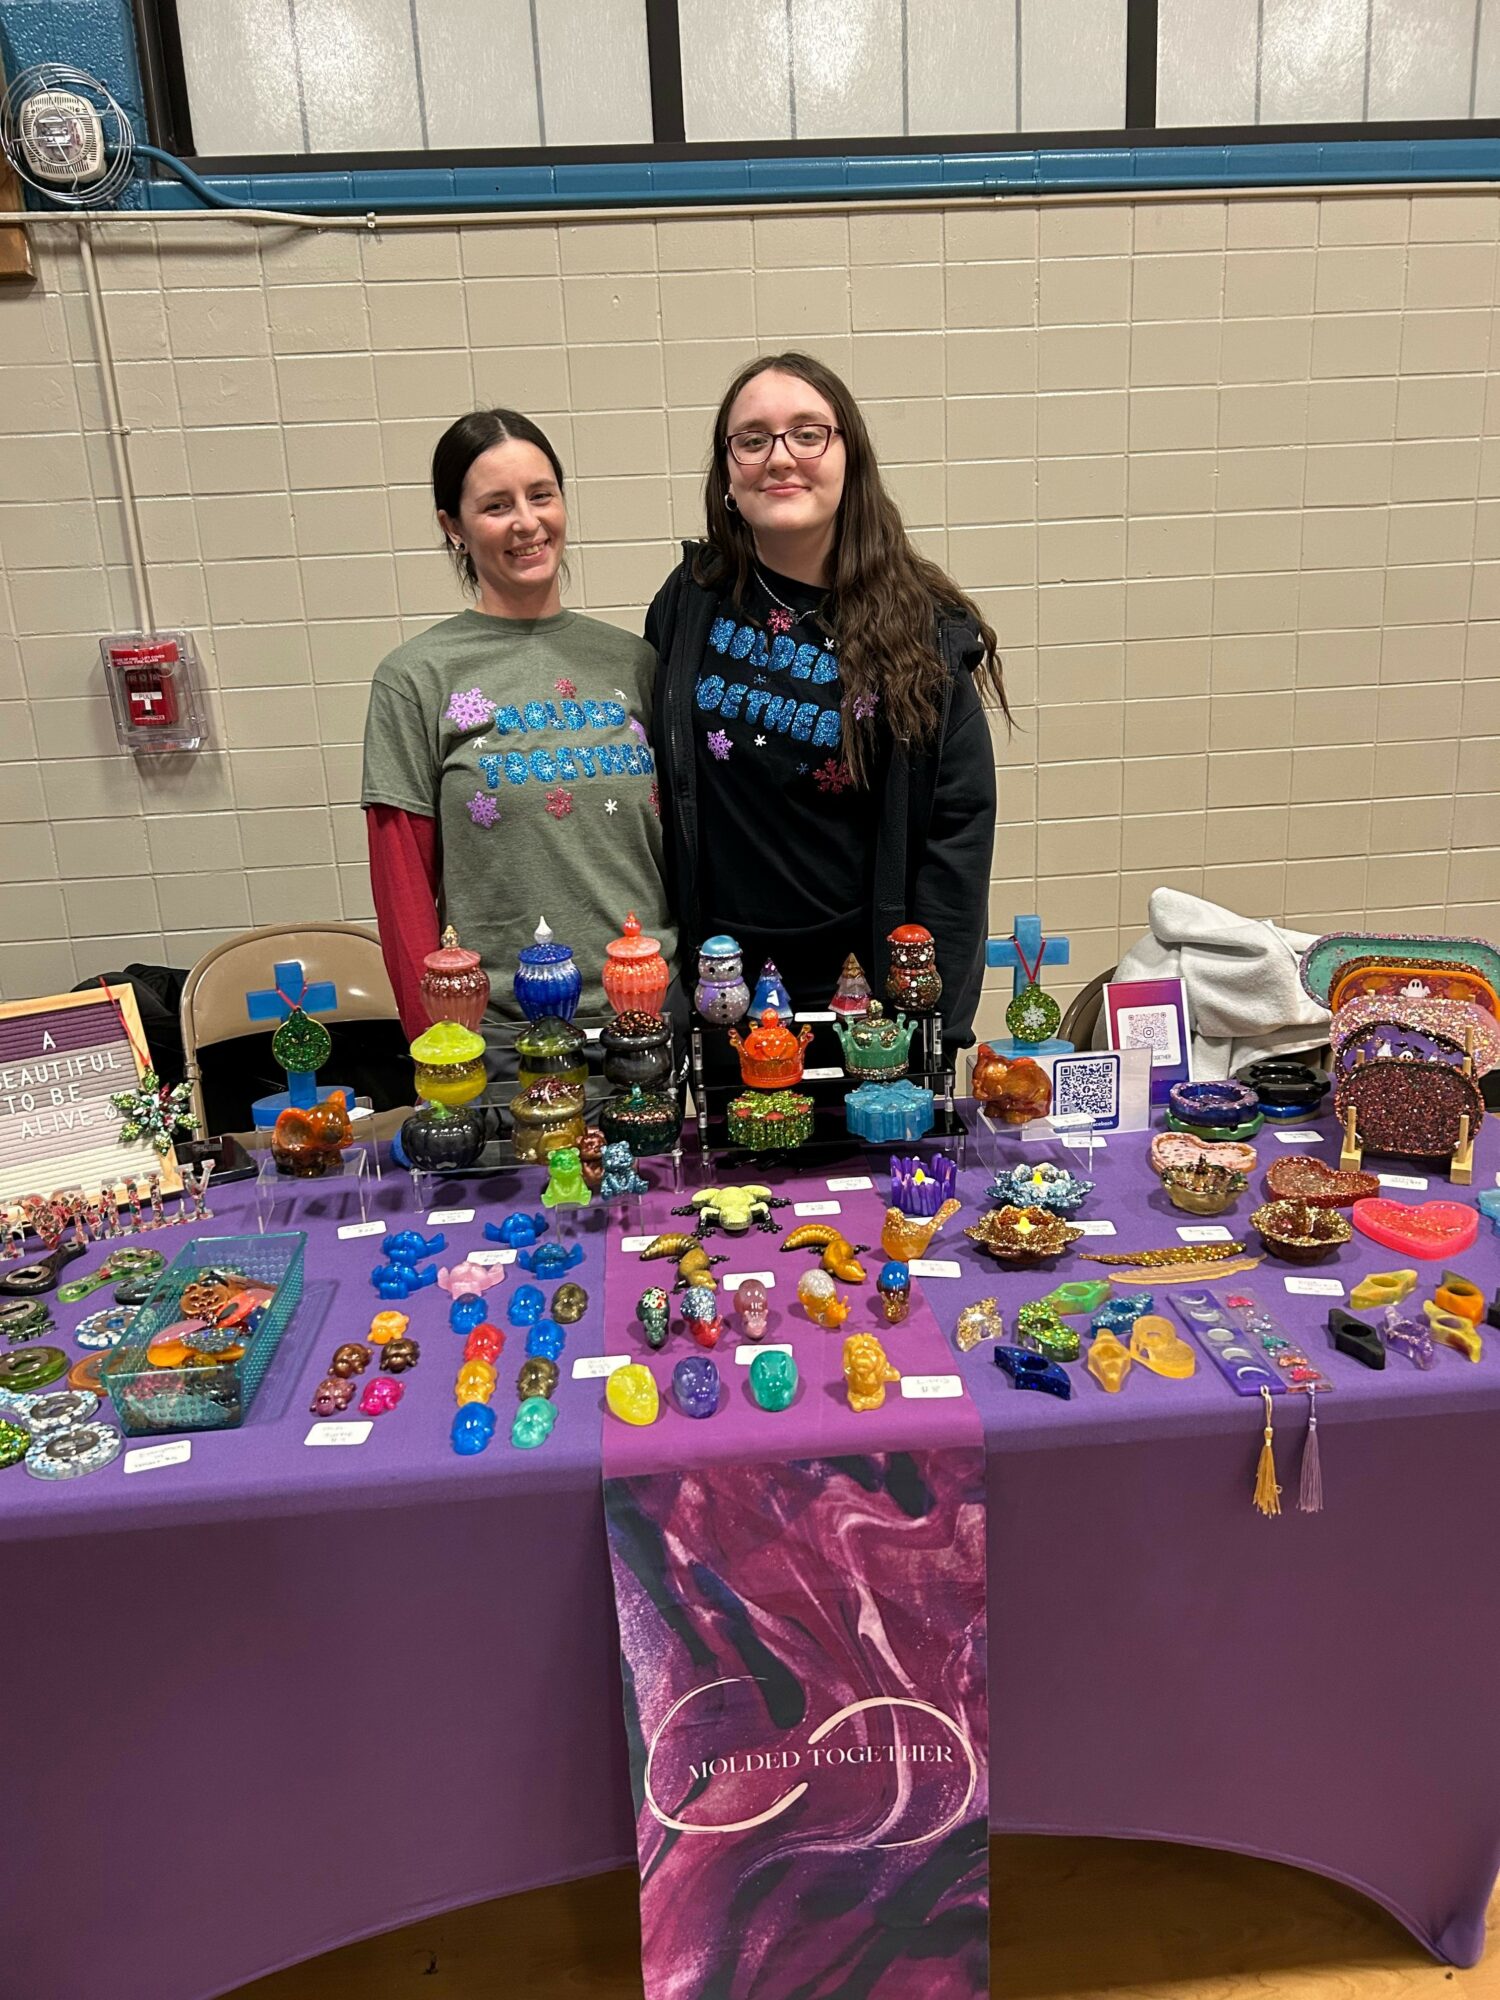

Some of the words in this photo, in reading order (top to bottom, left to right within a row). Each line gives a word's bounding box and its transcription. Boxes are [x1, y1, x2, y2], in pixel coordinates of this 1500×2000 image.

[707, 616, 841, 685] MOLDED
[493, 699, 627, 736] MOLDED
[695, 673, 842, 748] GETHER
[42, 1030, 57, 1051] A
[3, 1093, 35, 1115] TO
[50, 1082, 84, 1107] BE
[21, 1106, 95, 1141] ALIVE
[688, 1751, 801, 1780] MOLDED
[807, 1744, 955, 1767] TOGETHER
